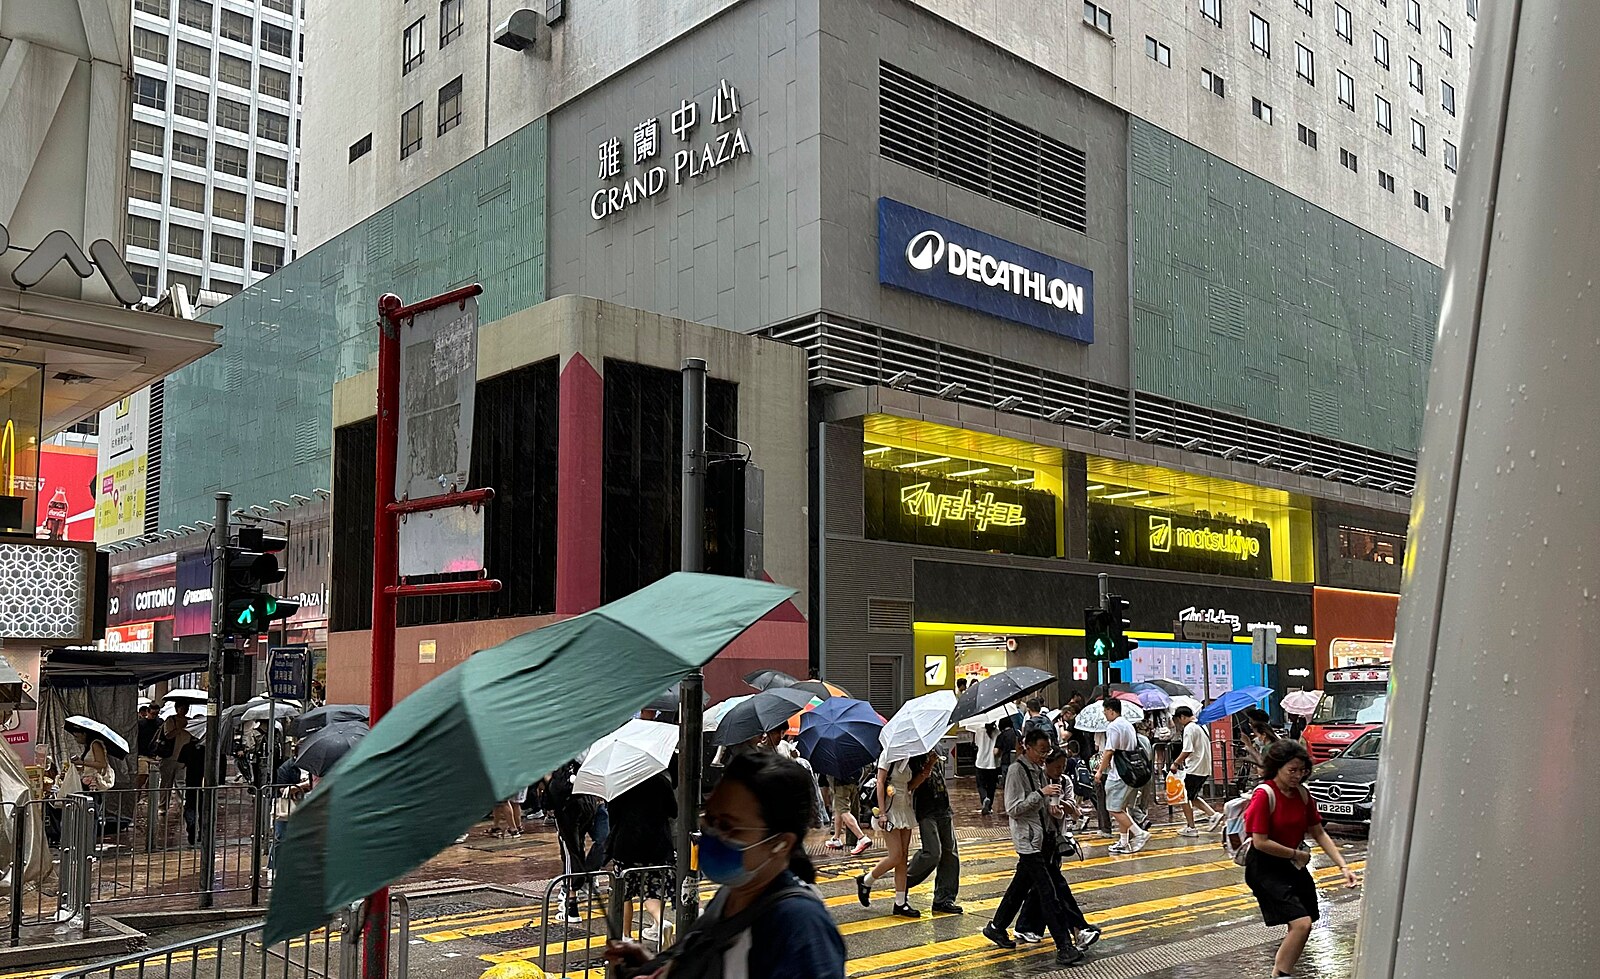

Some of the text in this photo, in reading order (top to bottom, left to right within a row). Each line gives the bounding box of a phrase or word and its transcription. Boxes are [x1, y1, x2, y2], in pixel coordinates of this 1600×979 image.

[597, 77, 742, 180] 雅蘭中心
[590, 126, 750, 220] GRAND PLAZA
[948, 242, 1084, 315] DECATHLON
[1176, 526, 1260, 560] matsukiyo
[136, 588, 167, 611] COTTON
[167, 586, 176, 607] O
[300, 592, 319, 607] PLAZA
[1333, 671, 1391, 681] 富豪雪
[1329, 804, 1352, 813] 2268
